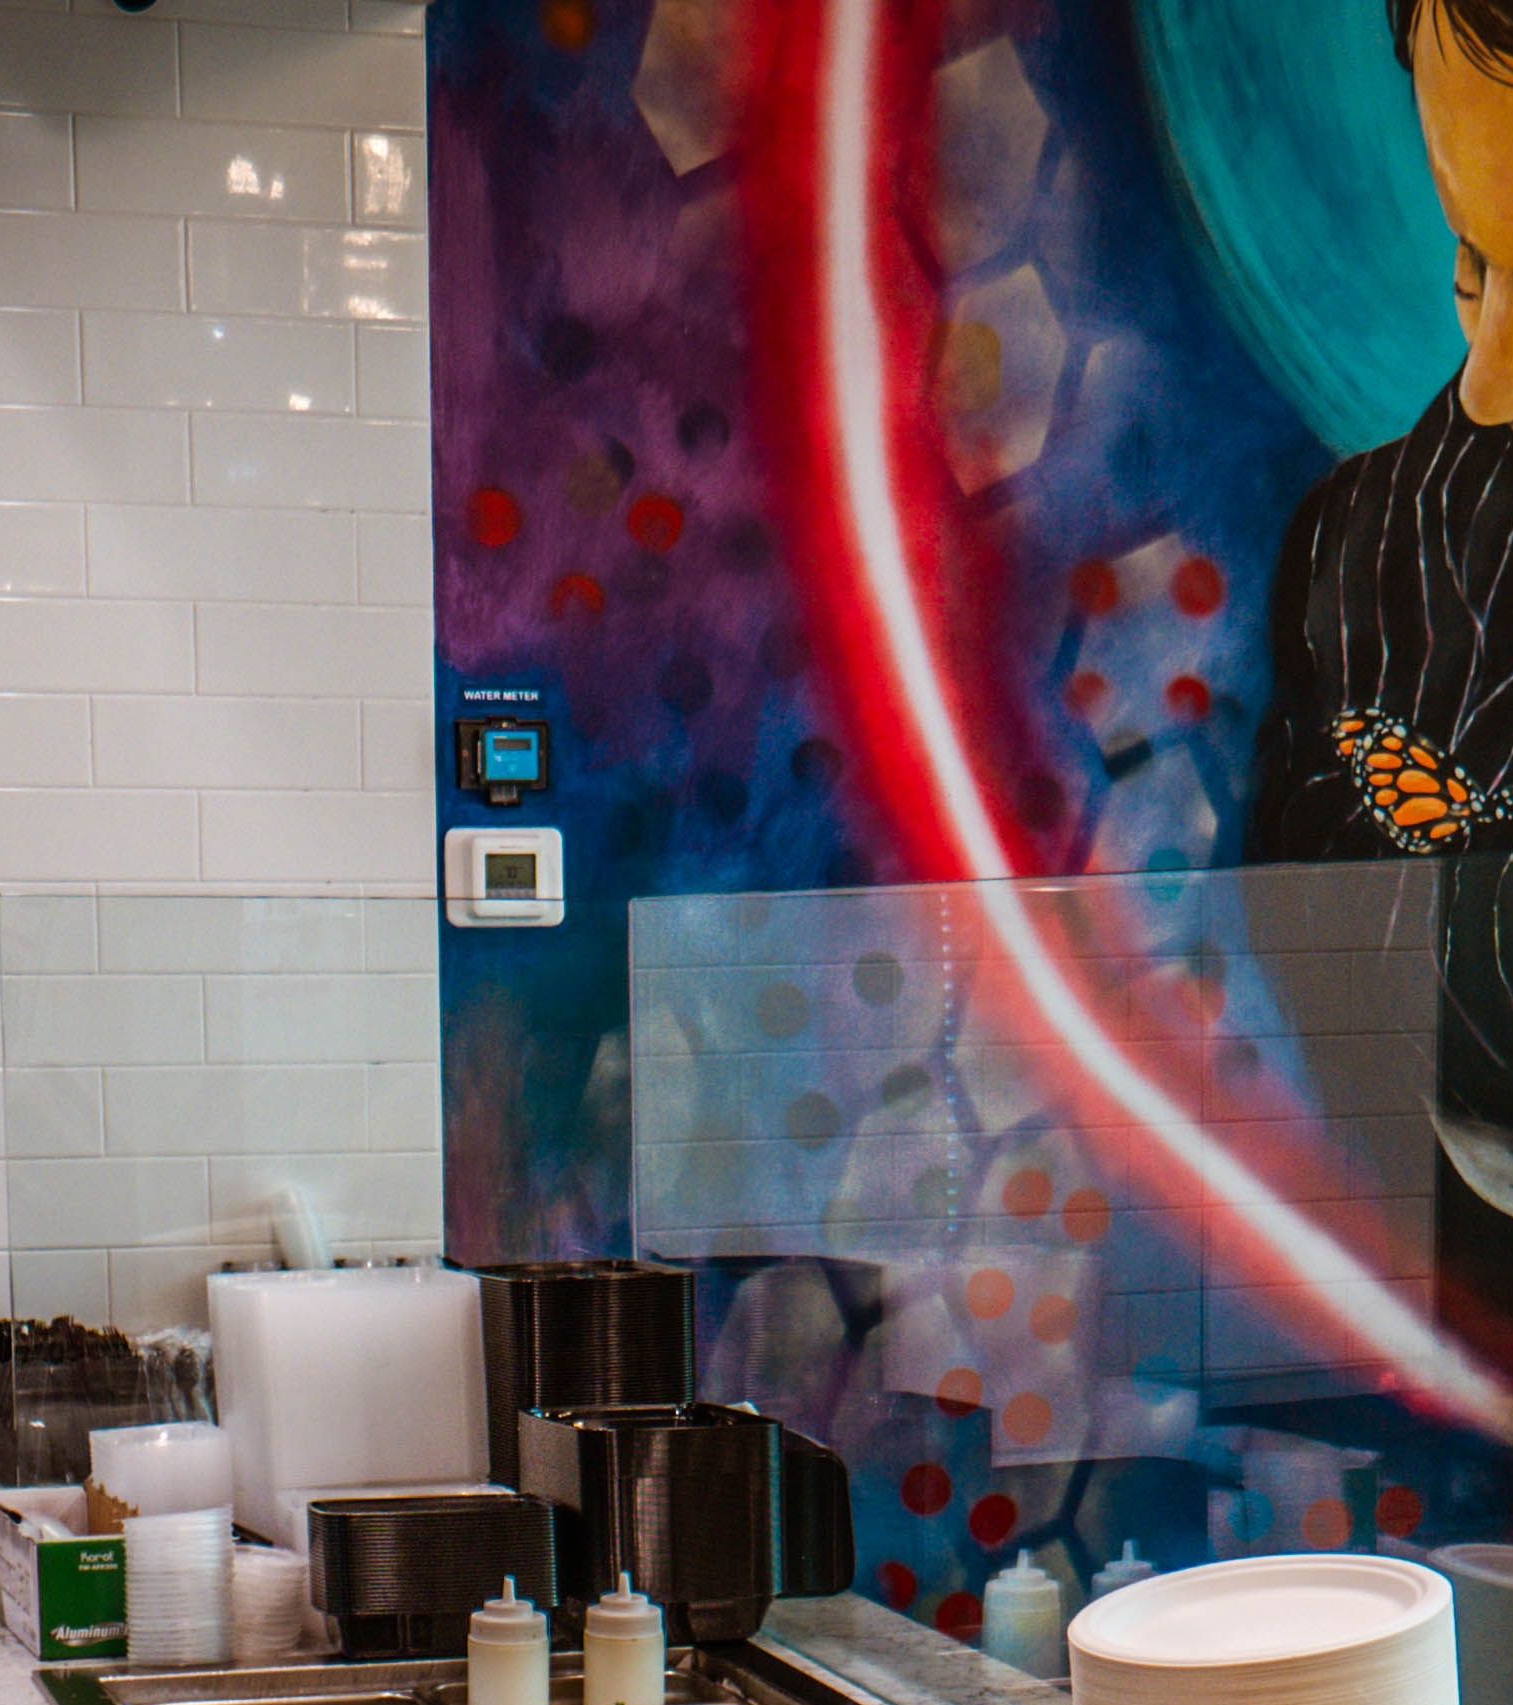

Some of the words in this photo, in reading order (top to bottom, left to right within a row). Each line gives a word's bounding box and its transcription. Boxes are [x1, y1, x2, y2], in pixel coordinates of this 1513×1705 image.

[463, 690, 501, 701] WATER
[502, 690, 538, 702] METER
[53, 1623, 120, 1640] Aluminum
